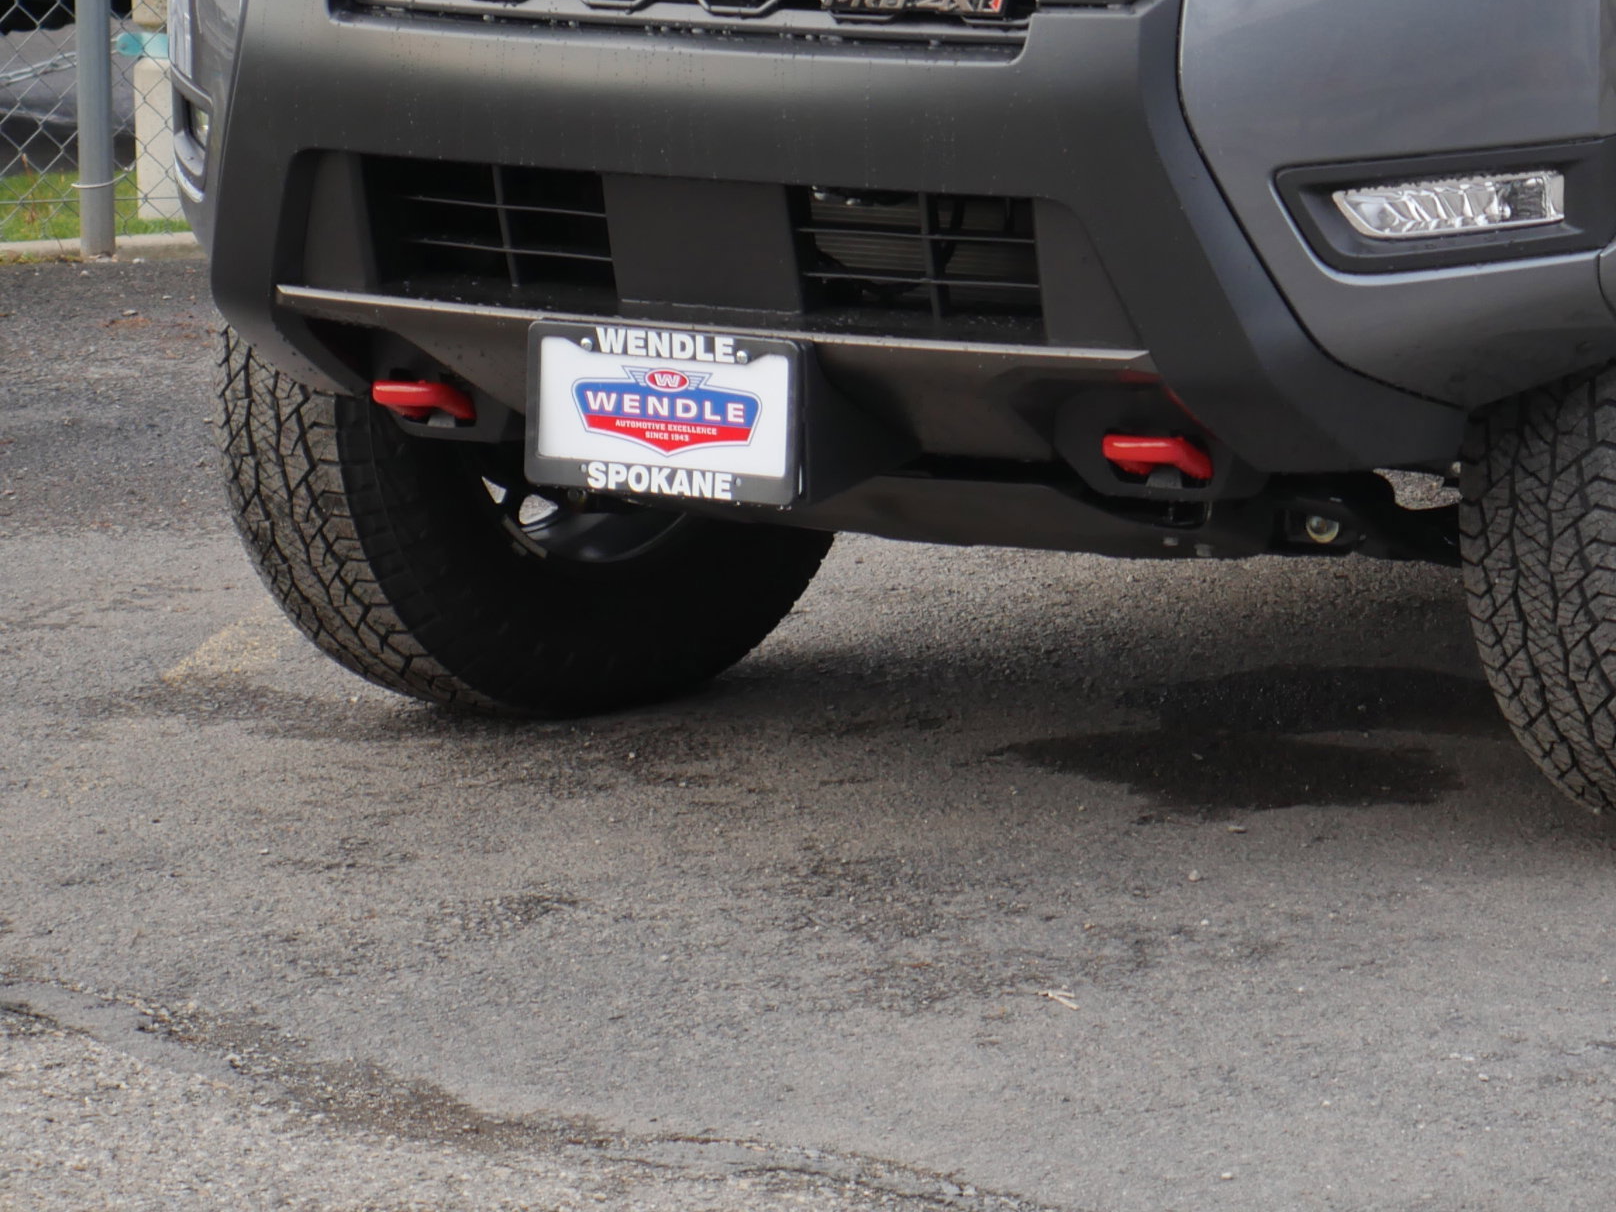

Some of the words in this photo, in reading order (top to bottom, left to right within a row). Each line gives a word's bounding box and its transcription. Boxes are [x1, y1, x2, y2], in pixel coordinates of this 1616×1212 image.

[597, 327, 735, 363] WENDLE
[586, 391, 745, 423] WENDLE
[615, 419, 666, 432] AUTOMOTIVE
[667, 423, 718, 436] EXCELLENCE
[645, 431, 669, 440] SINCE
[587, 462, 732, 500] SPOKANE
